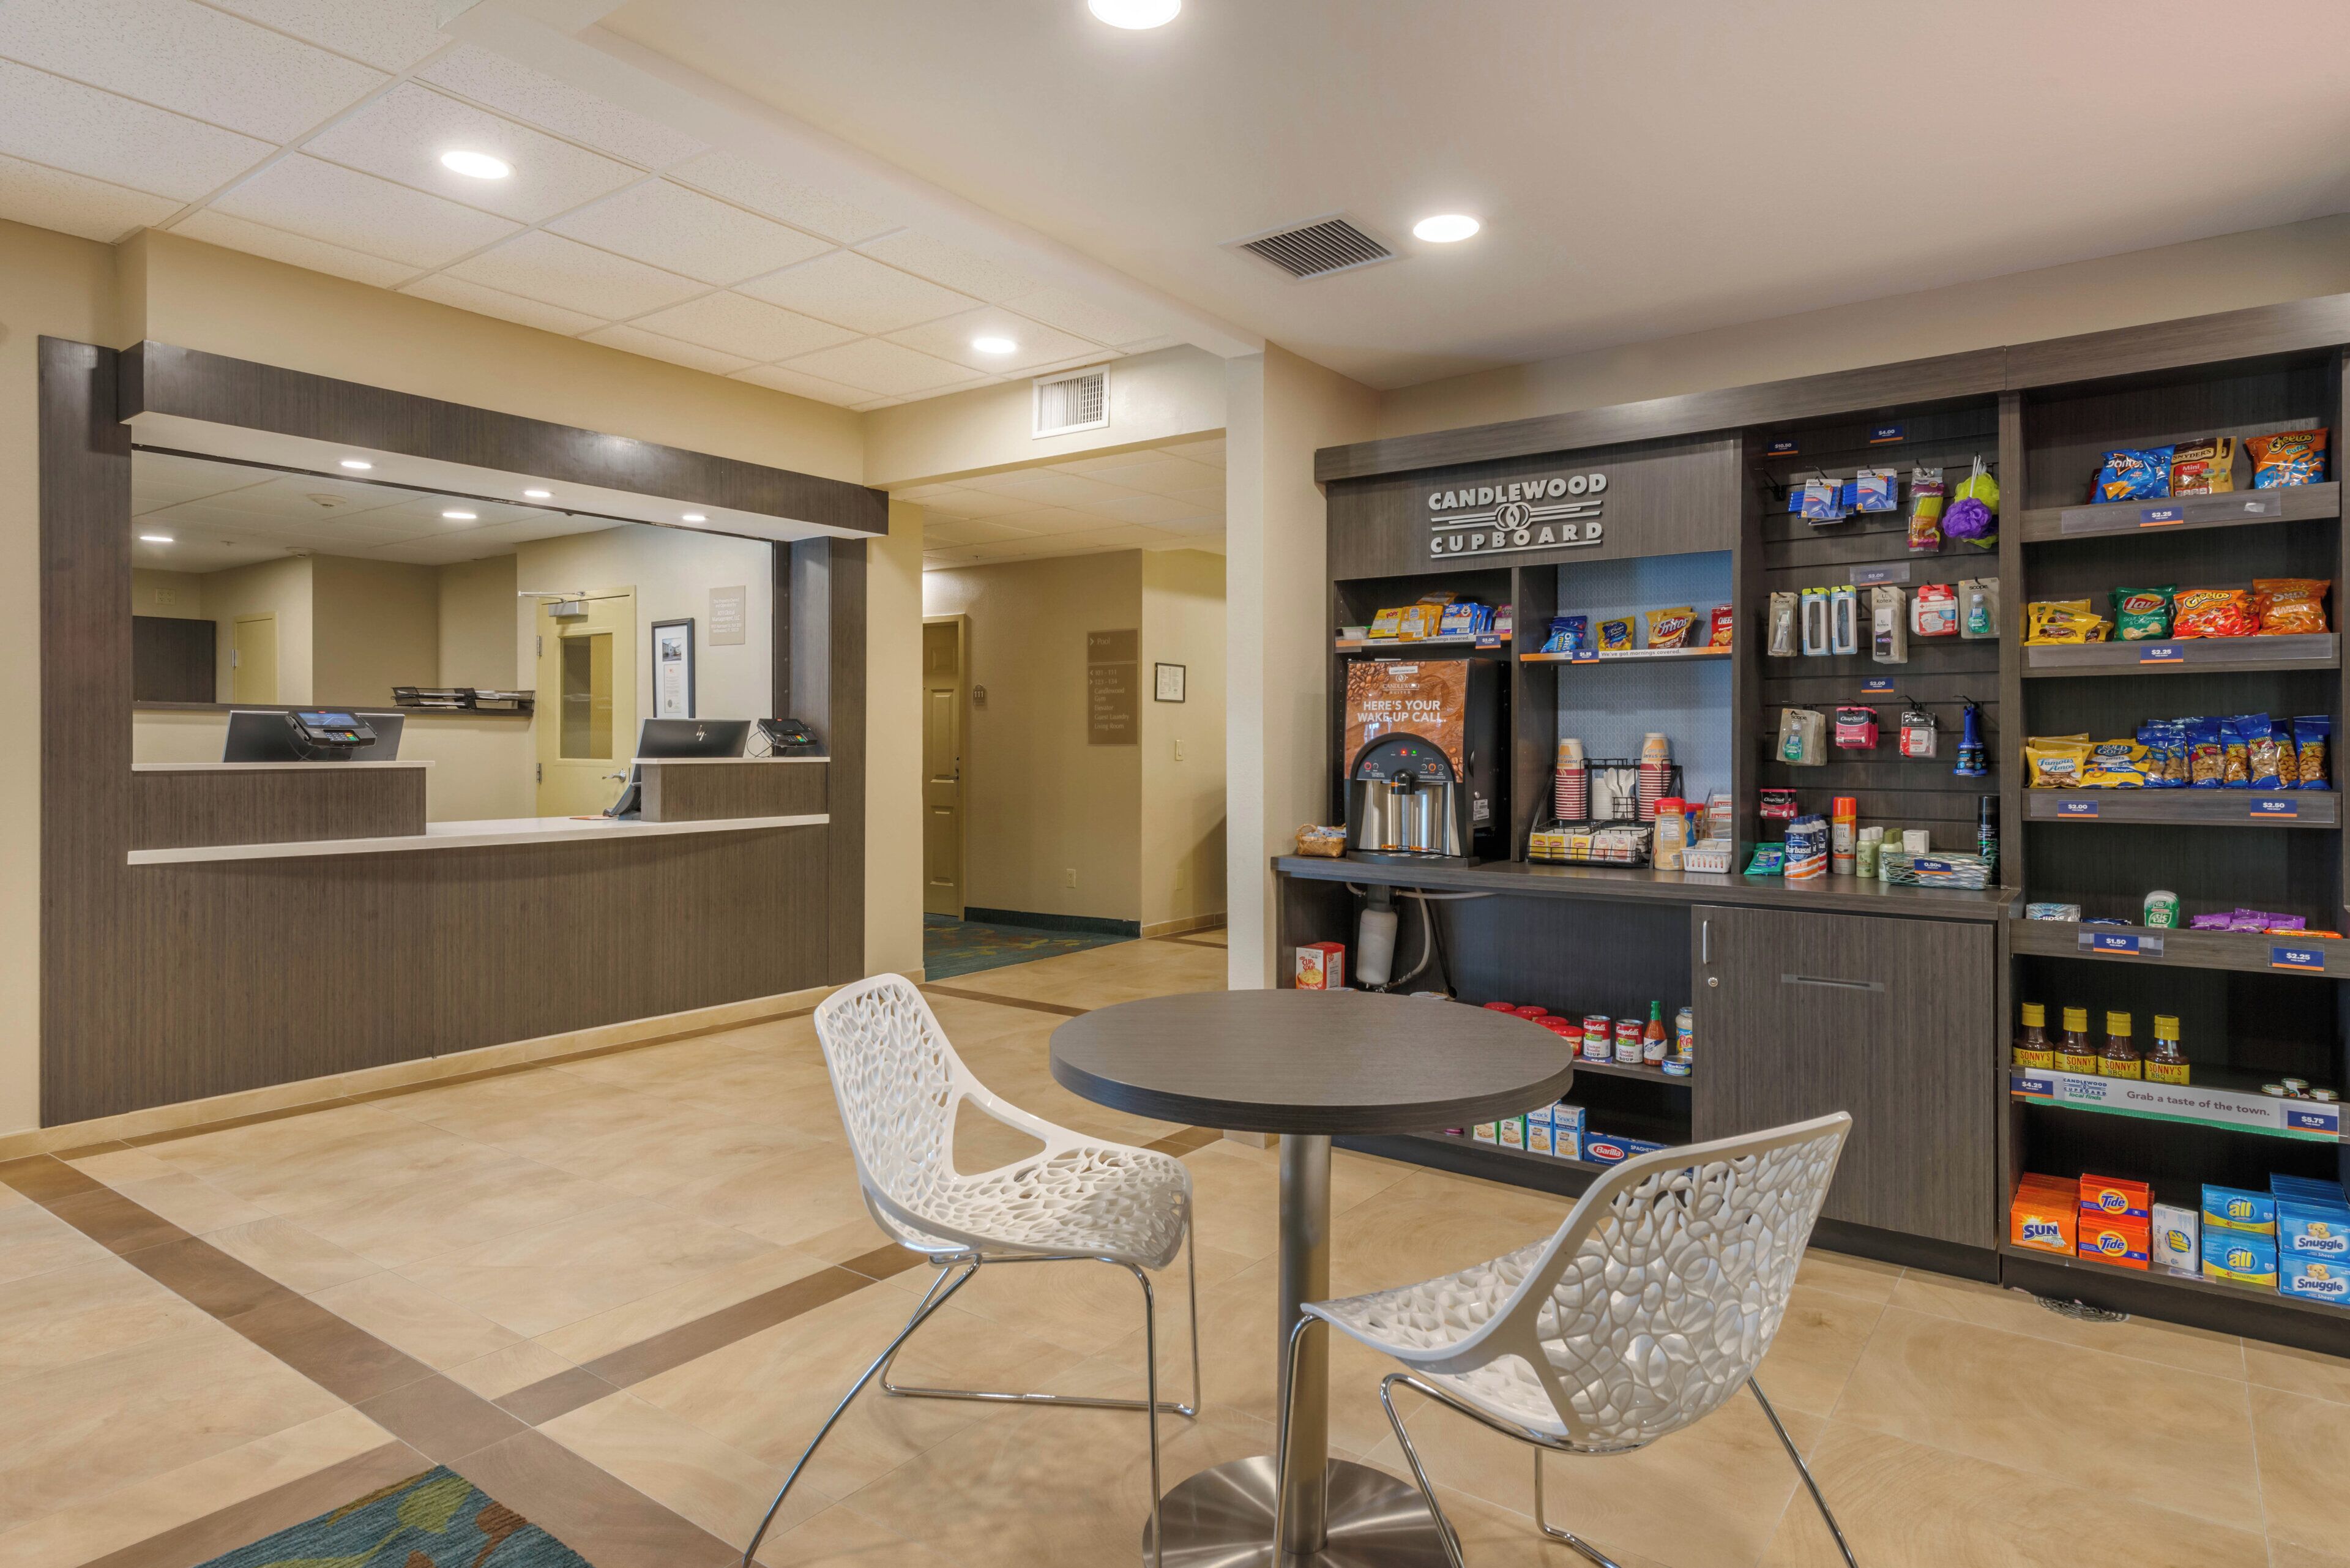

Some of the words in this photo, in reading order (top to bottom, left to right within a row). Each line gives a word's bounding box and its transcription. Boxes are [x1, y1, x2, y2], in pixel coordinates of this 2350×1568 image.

[2268, 433, 2313, 452] Cheetos
[2173, 450, 2211, 460] SNYDER'S
[2285, 444, 2308, 455] Puffs
[1428, 473, 1607, 510] CANDLEWOOD
[1431, 522, 1603, 553] CUPBOARD
[2185, 592, 2229, 608] Cheetos
[1658, 618, 1688, 637] Fritos
[1562, 633, 1572, 651] ORE
[1363, 700, 1401, 711] HERE'S
[1405, 700, 1441, 711] YOUR
[1357, 712, 1408, 722] WAKE-UP
[1412, 712, 1447, 723] CALL.
[1785, 845, 1811, 854] Barbasol
[1679, 1035, 1693, 1048] RA
[2020, 1050, 2050, 1061] SONNY'S
[2067, 1056, 2095, 1066] SONNY'S
[2105, 1060, 2137, 1072] SONNY'S
[2149, 1064, 2182, 1076] SONNY'S
[2063, 1078, 2107, 1087] CANDLEWOOD
[2064, 1087, 2106, 1096] CUPBOARD
[2127, 1091, 2154, 1101] Grab
[2167, 1096, 2195, 1107] taste
[2199, 1099, 2210, 1108] of
[2214, 1101, 2232, 1111] the
[2236, 1105, 2270, 1116] town.
[1595, 1146, 1621, 1157] Barilla
[2101, 1195, 2125, 1208] Tide
[2228, 1201, 2252, 1217] all
[2023, 1225, 2059, 1241] SUN
[2100, 1236, 2125, 1250] Tide
[2169, 1230, 2190, 1253] all
[2298, 1238, 2343, 1250] Snuggle
[2228, 1252, 2252, 1267] all
[2297, 1279, 2343, 1292] Snuggle
